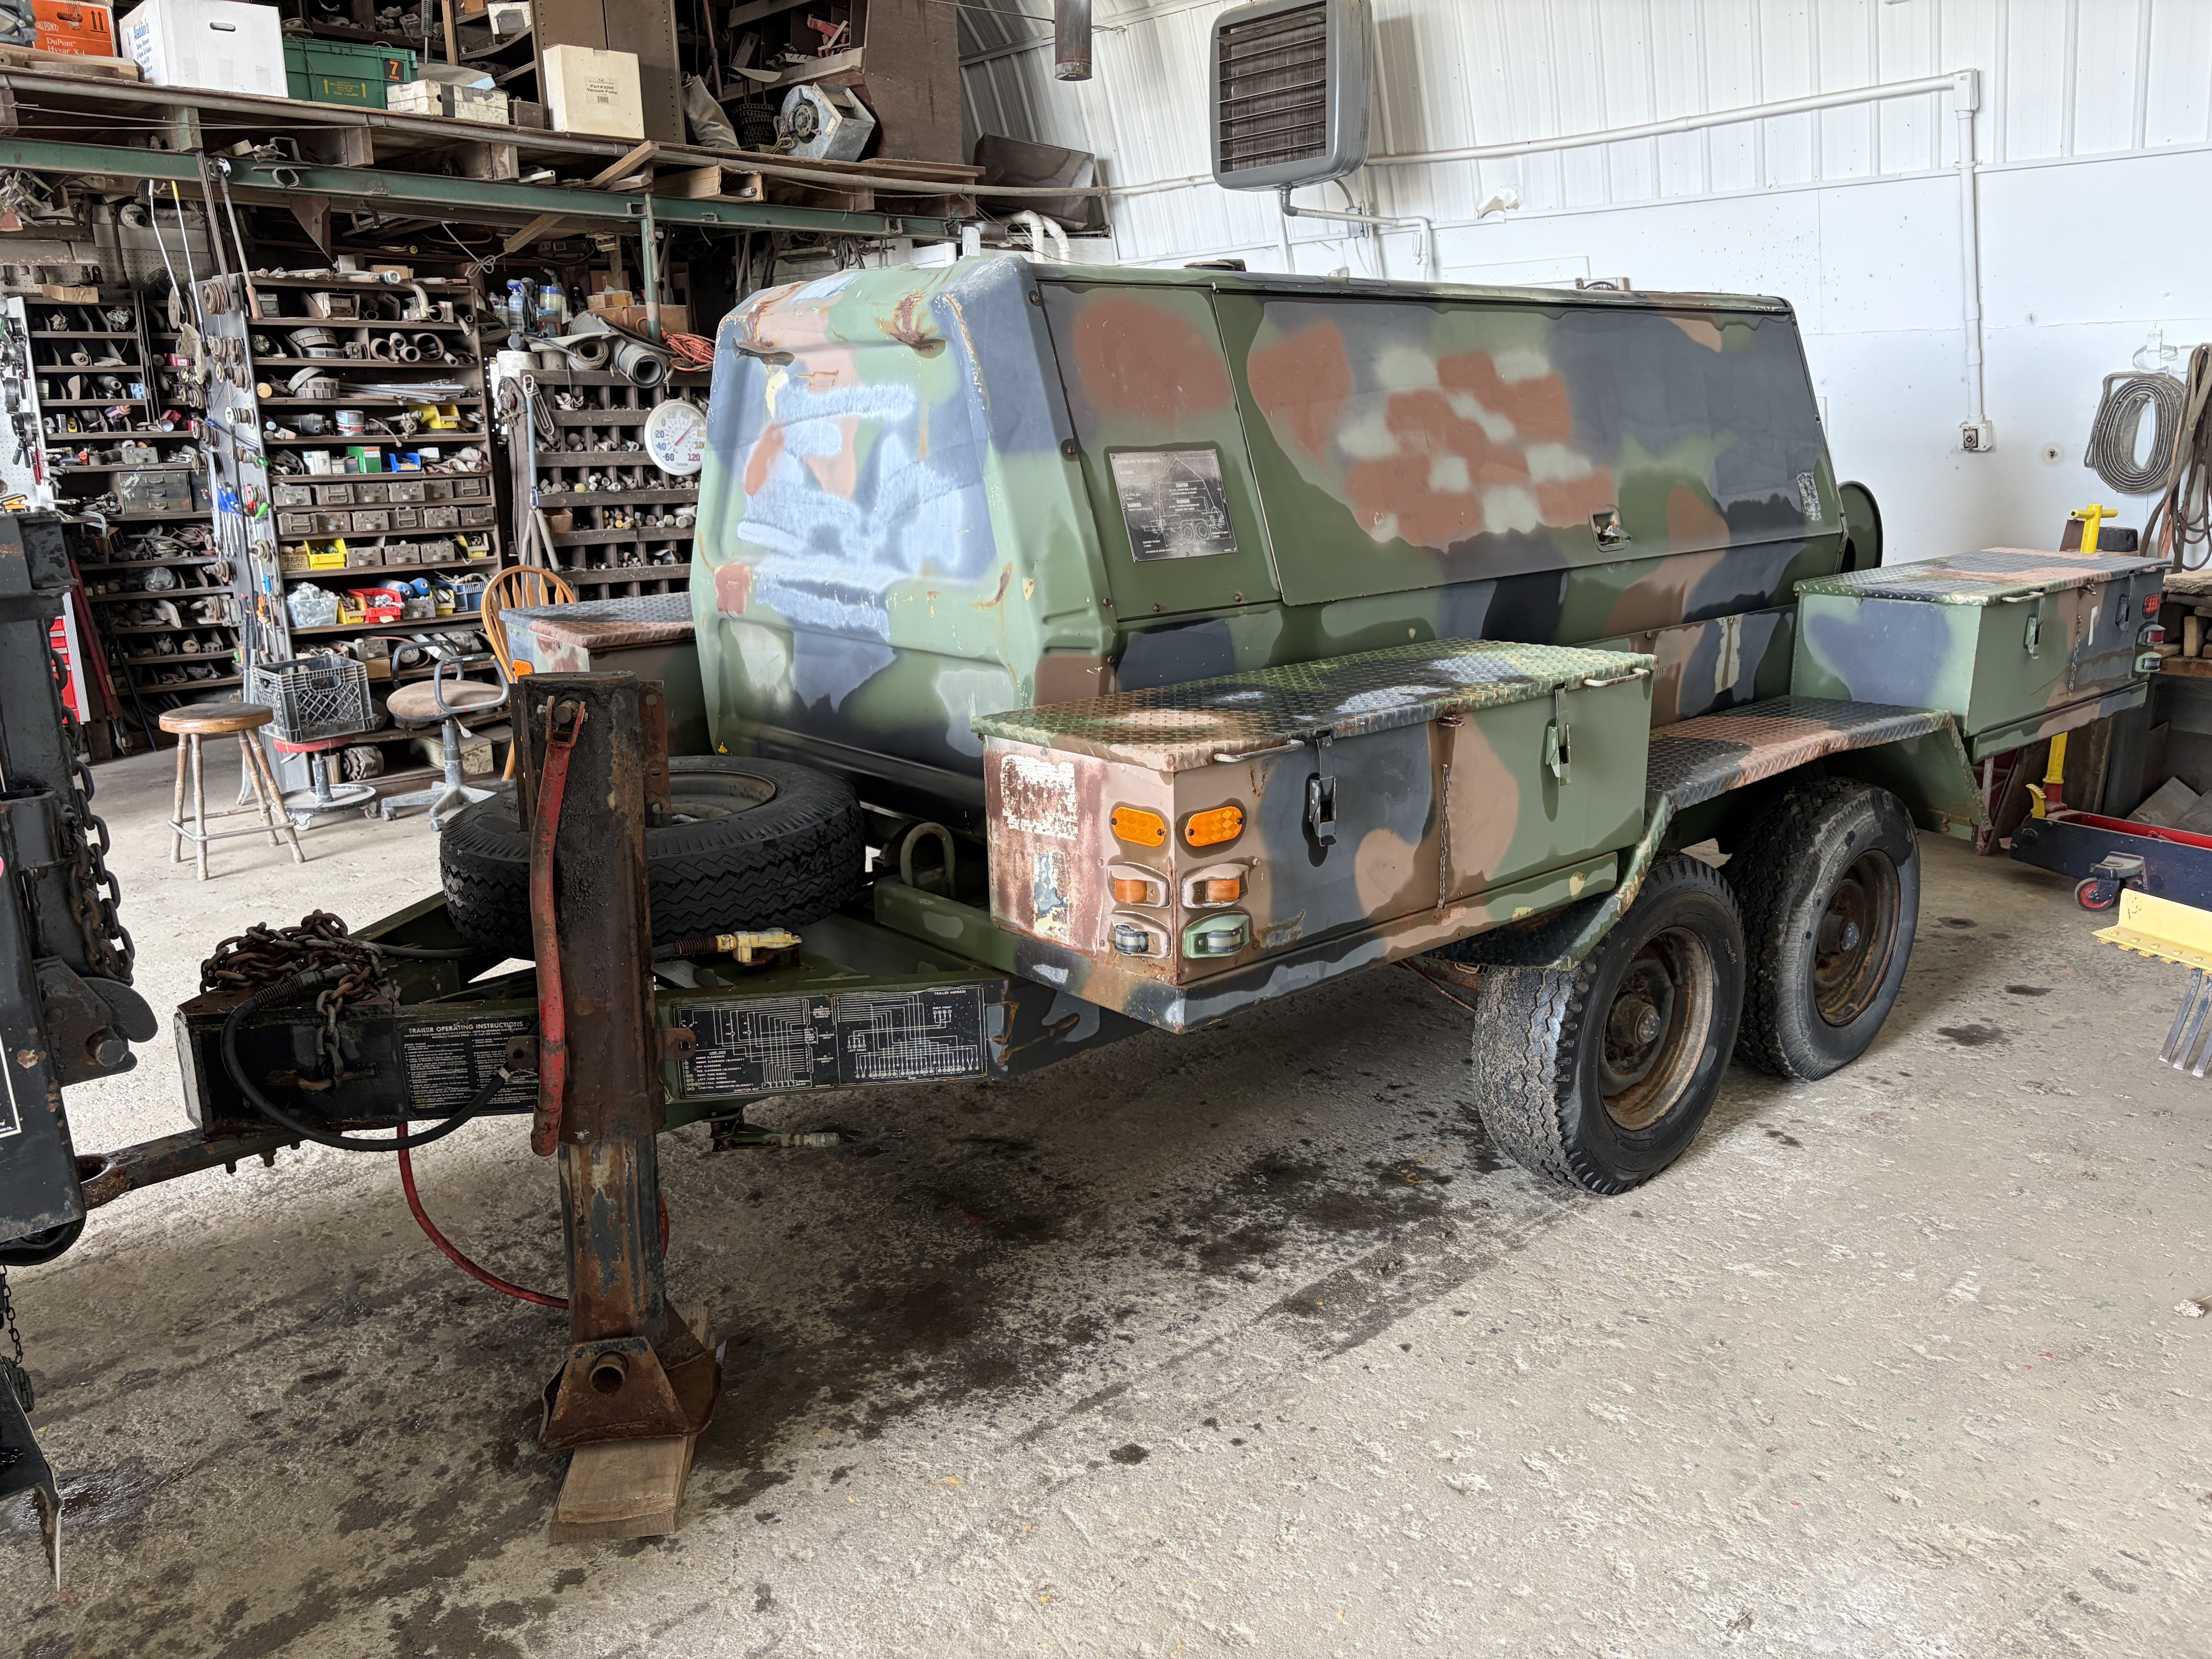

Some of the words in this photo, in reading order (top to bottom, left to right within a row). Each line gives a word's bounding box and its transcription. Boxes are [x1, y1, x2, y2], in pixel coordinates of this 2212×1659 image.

[37, 21, 58, 31] DUPONT
[134, 18, 149, 41] Aladdin's
[390, 61, 398, 75] 7
[667, 410, 676, 419] 20
[680, 411, 690, 419] 40
[655, 442, 666, 450] -40
[663, 453, 674, 461] -60
[688, 453, 700, 462] 120
